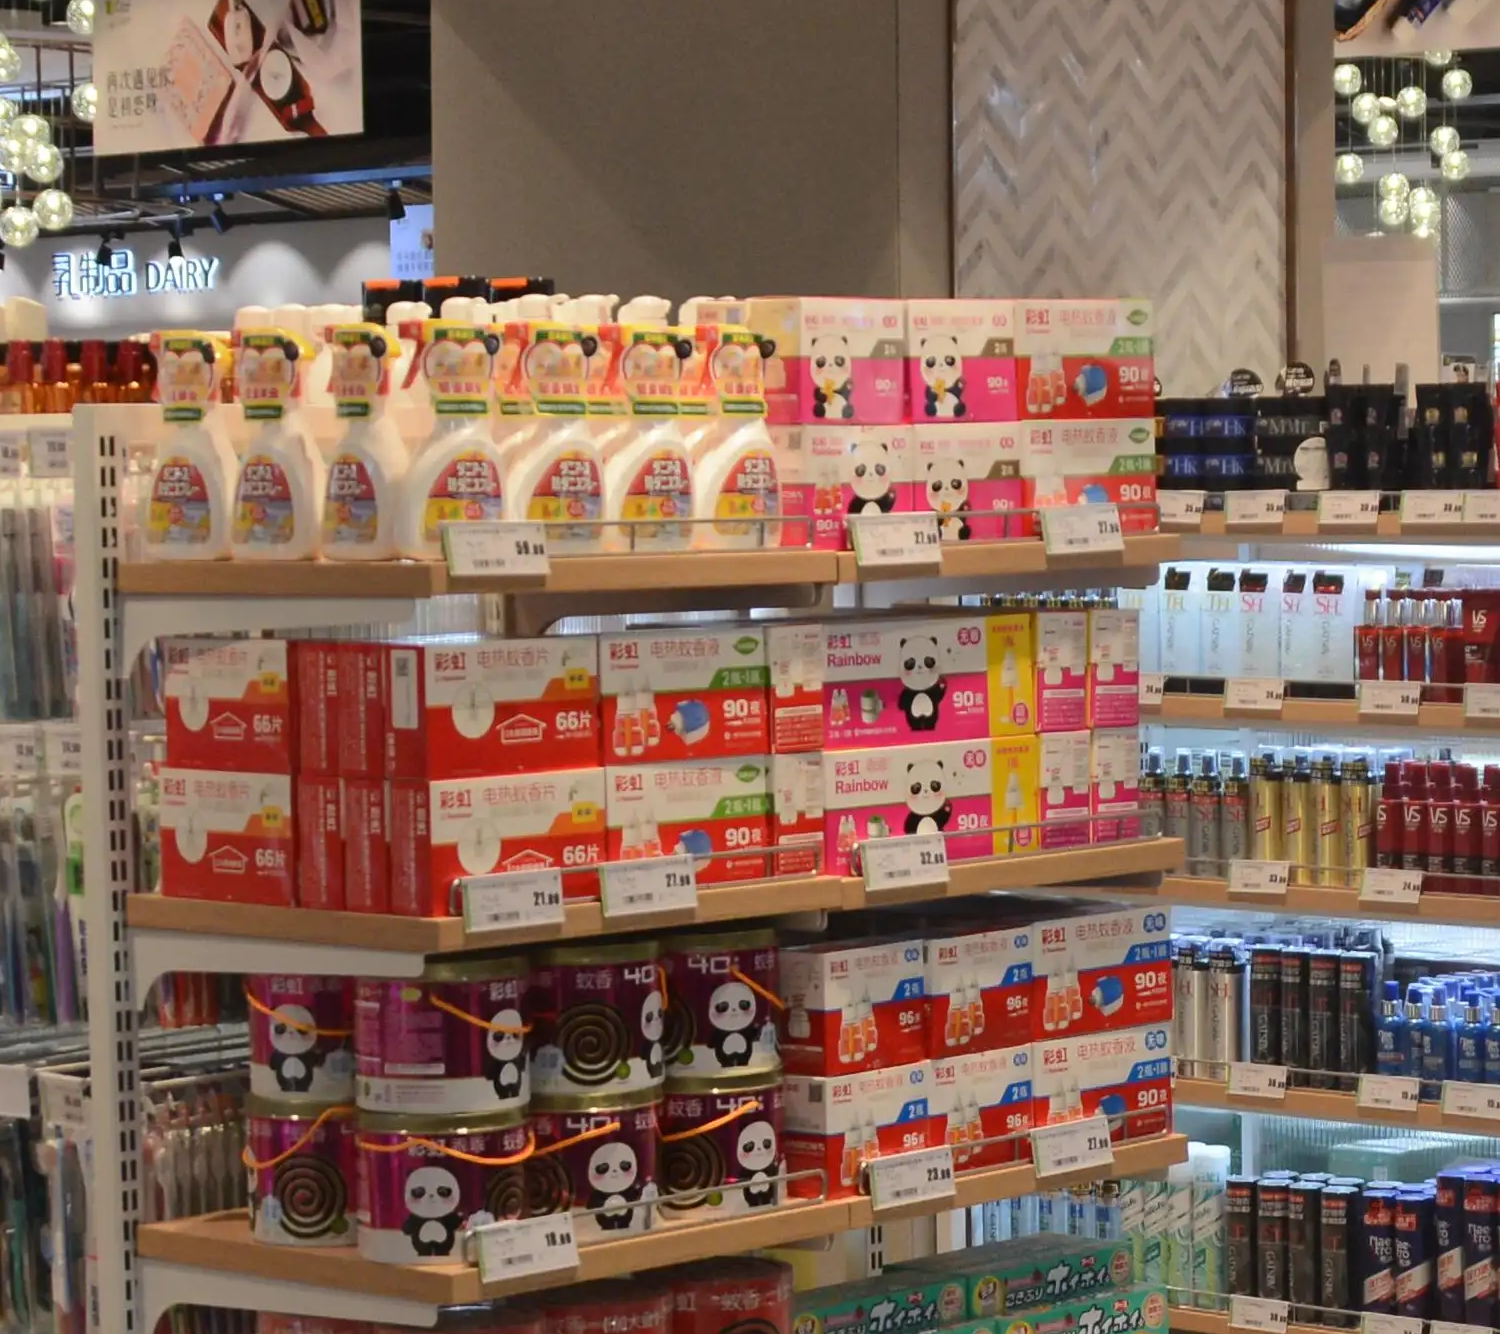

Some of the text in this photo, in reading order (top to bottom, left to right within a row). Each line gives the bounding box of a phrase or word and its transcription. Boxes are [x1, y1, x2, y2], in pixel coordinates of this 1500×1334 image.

[52, 249, 220, 301] 乳制品 DAIRY
[434, 651, 466, 671] 彩虹
[609, 641, 639, 661] 彩虹
[827, 652, 882, 668] Rainbow
[555, 710, 592, 732] 66片
[614, 774, 644, 794] 彩虹
[835, 778, 889, 796] Rainbow
[440, 787, 473, 809] 彩虹
[1403, 805, 1421, 823] VS
[1429, 806, 1448, 825] VS
[1454, 807, 1472, 826] VS
[562, 844, 600, 867] 66片
[1041, 925, 1066, 946] 彩虹
[1075, 919, 1134, 941] 电热蚊香液
[1134, 971, 1168, 989] 90夜
[1042, 1047, 1068, 1067] 彩虹
[1077, 1036, 1137, 1061] 电热蚊香液
[1047, 1260, 1112, 1297] ホイホイ
[719, 1289, 760, 1311] 蚊香
[869, 1299, 940, 1334] ホイホイ
